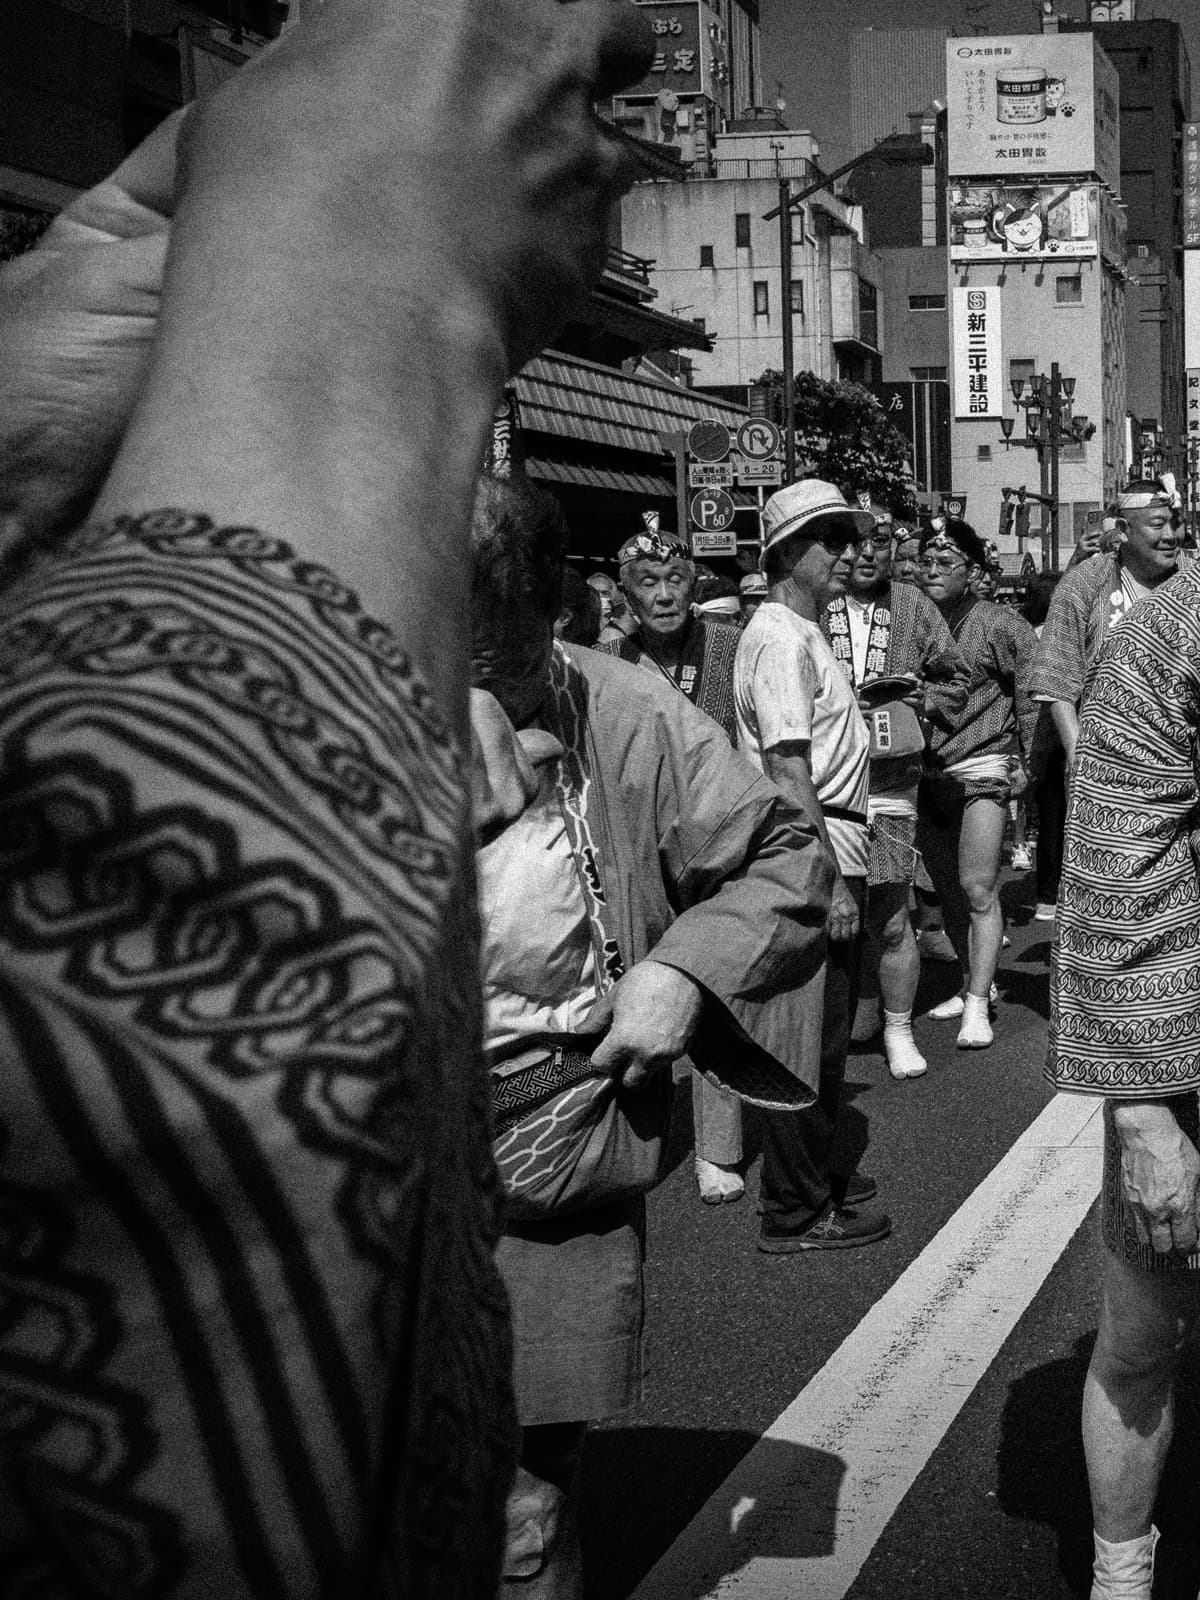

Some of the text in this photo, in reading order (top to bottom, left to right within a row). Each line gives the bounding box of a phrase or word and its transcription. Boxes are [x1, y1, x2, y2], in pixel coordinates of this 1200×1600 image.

[974, 47, 1012, 56] 太田胃散
[1002, 83, 1041, 93] 太田胃散
[995, 147, 1047, 159] 太田胃散
[1186, 233, 1200, 243] 5F
[967, 312, 989, 414] 新三平建設
[701, 500, 718, 527] P
